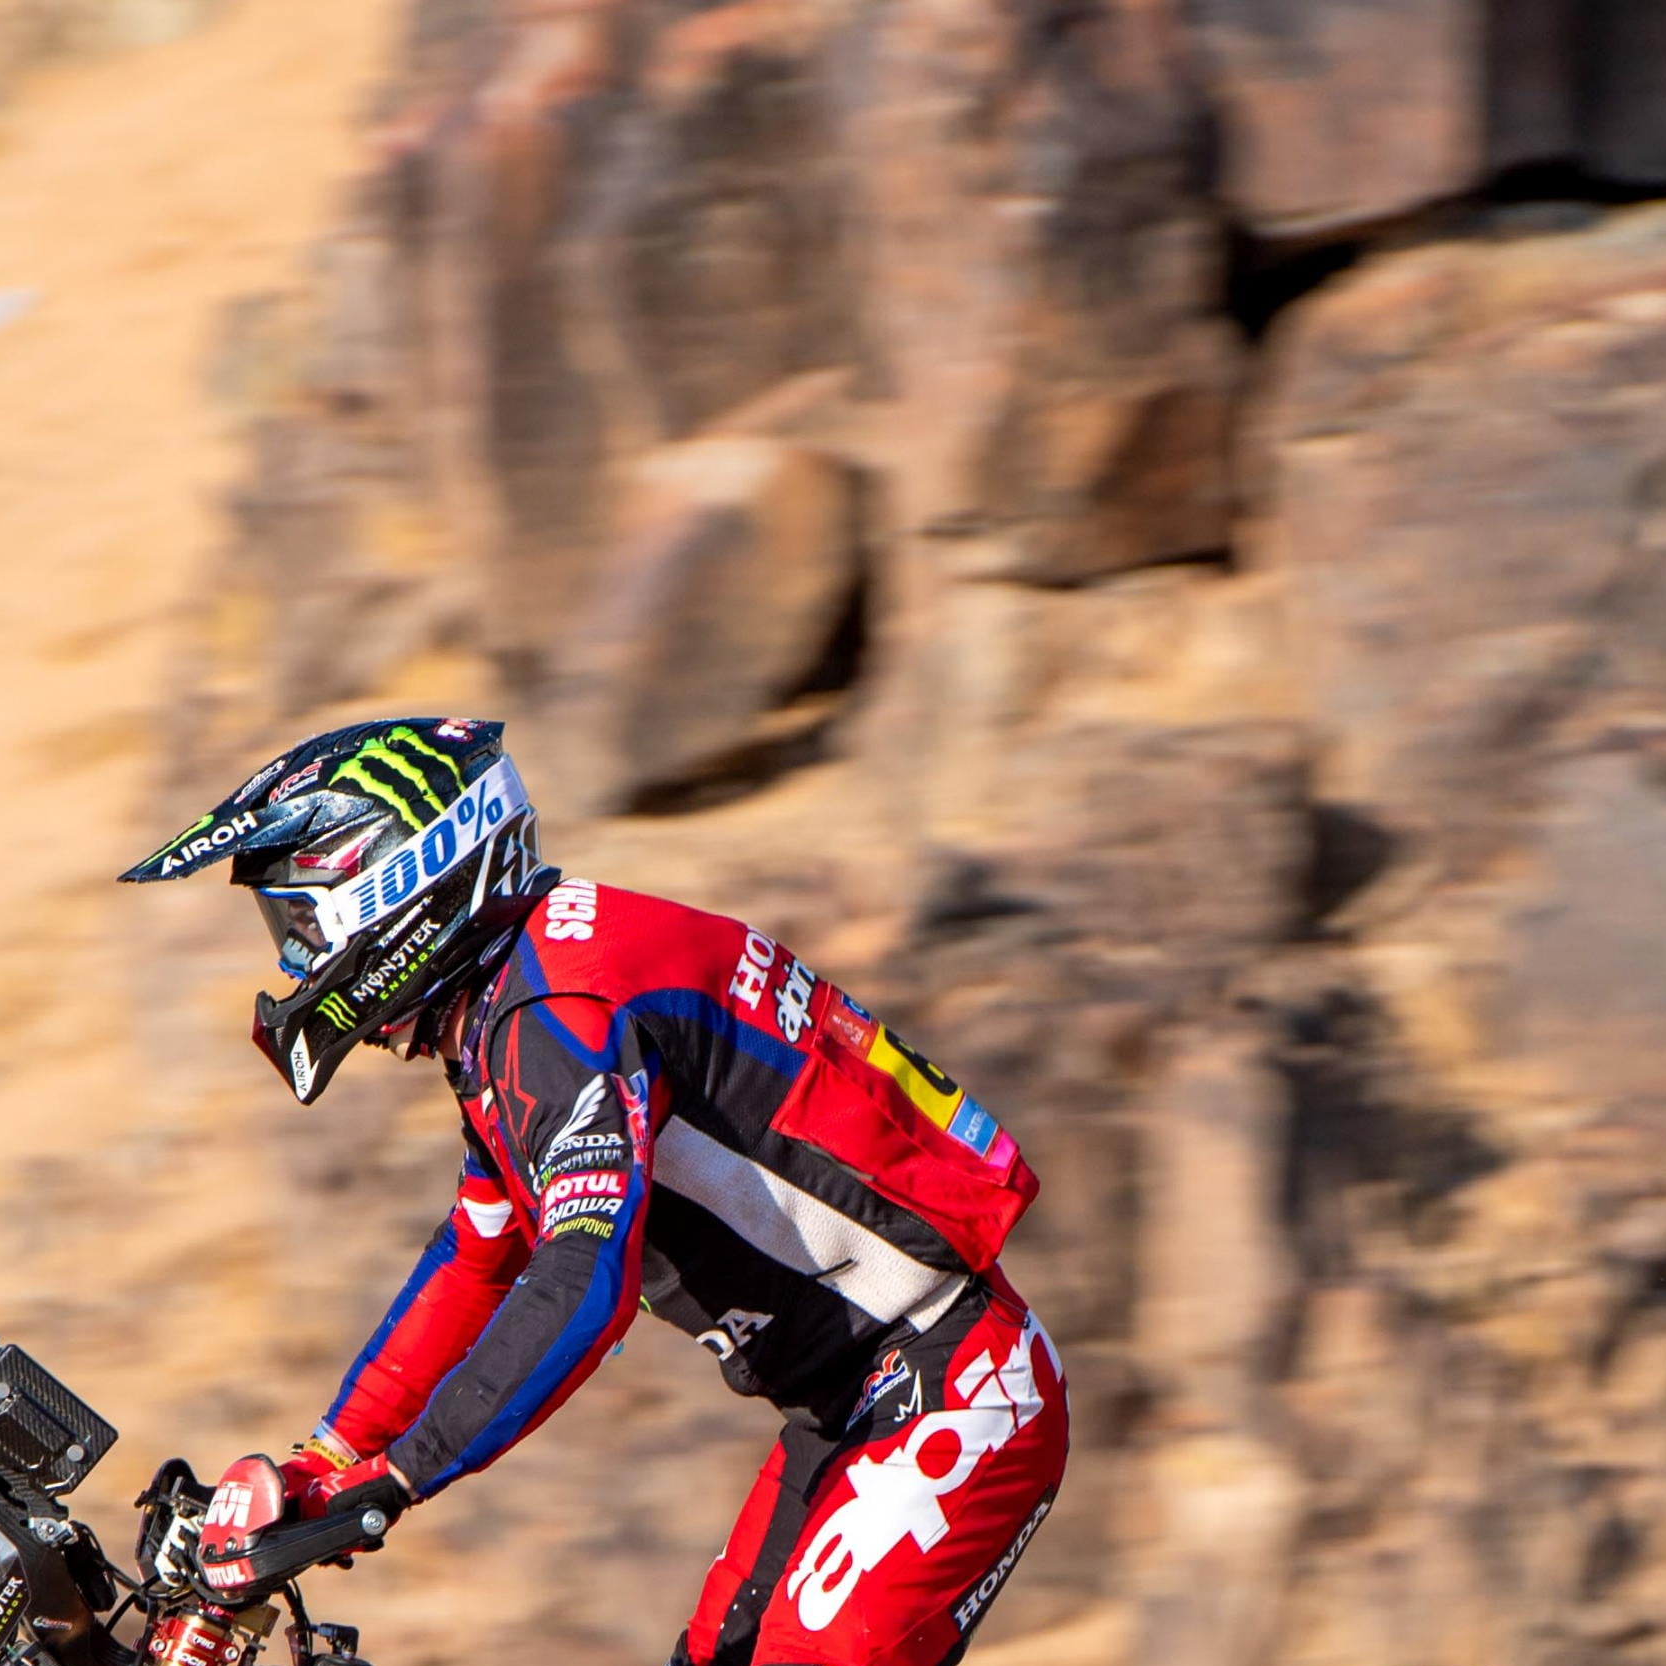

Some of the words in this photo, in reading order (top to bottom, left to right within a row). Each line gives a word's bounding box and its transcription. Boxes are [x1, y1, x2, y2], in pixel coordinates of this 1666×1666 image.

[161, 811, 258, 876] AIROH
[349, 779, 504, 925] 100%
[352, 918, 442, 1003] MONSTER
[379, 942, 436, 1001] ENERGY
[542, 1199, 624, 1233] SHOWA
[954, 1502, 1051, 1631] HONDA
